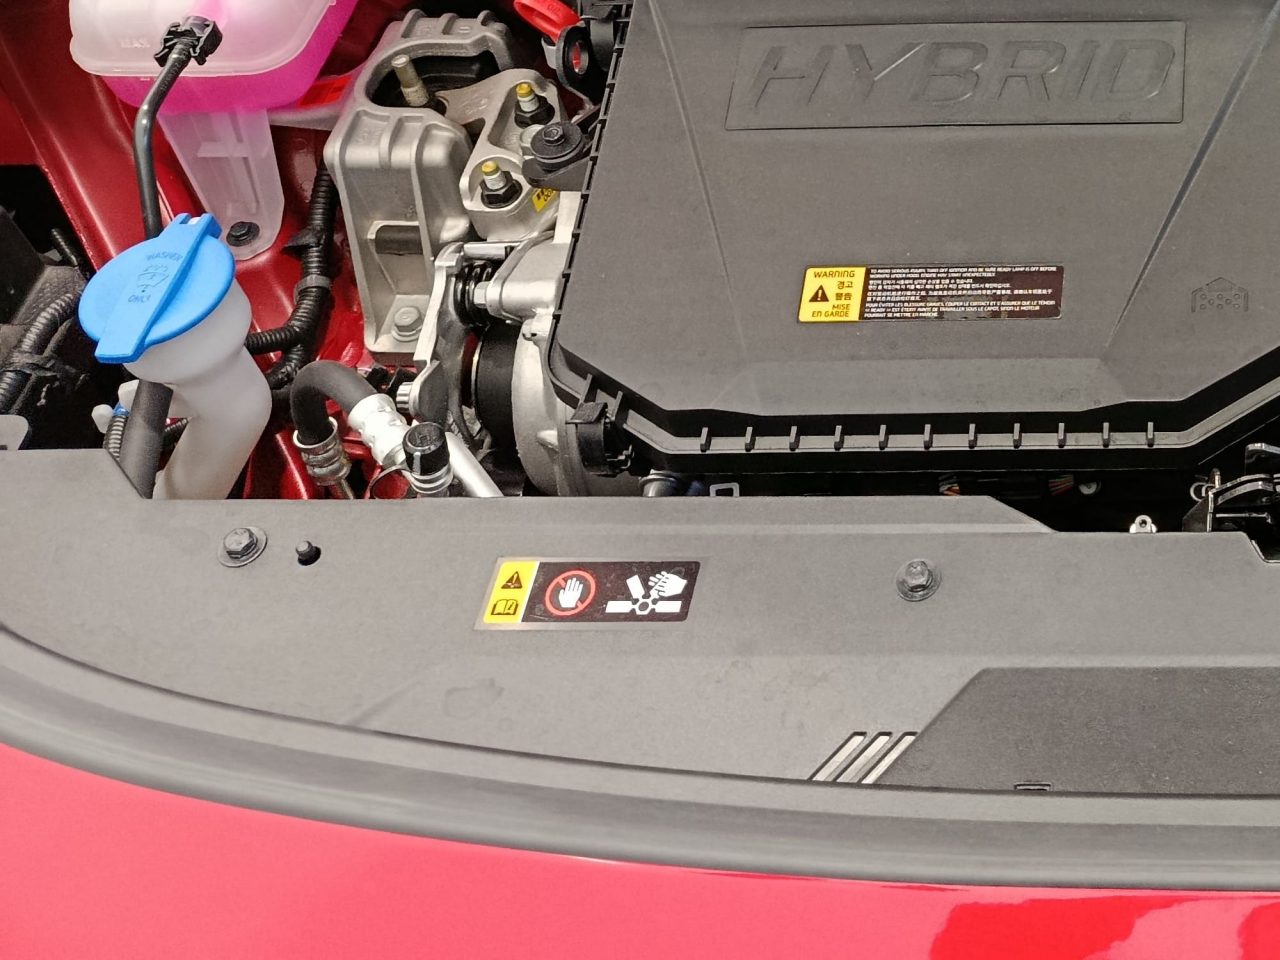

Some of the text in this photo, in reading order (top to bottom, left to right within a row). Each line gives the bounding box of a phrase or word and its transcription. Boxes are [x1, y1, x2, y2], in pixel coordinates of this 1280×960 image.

[754, 40, 1176, 109] HYBRID
[146, 252, 183, 262] WASHER
[814, 270, 855, 278] WARNING
[837, 281, 853, 290] 경고
[812, 310, 850, 318] EN GARDE
